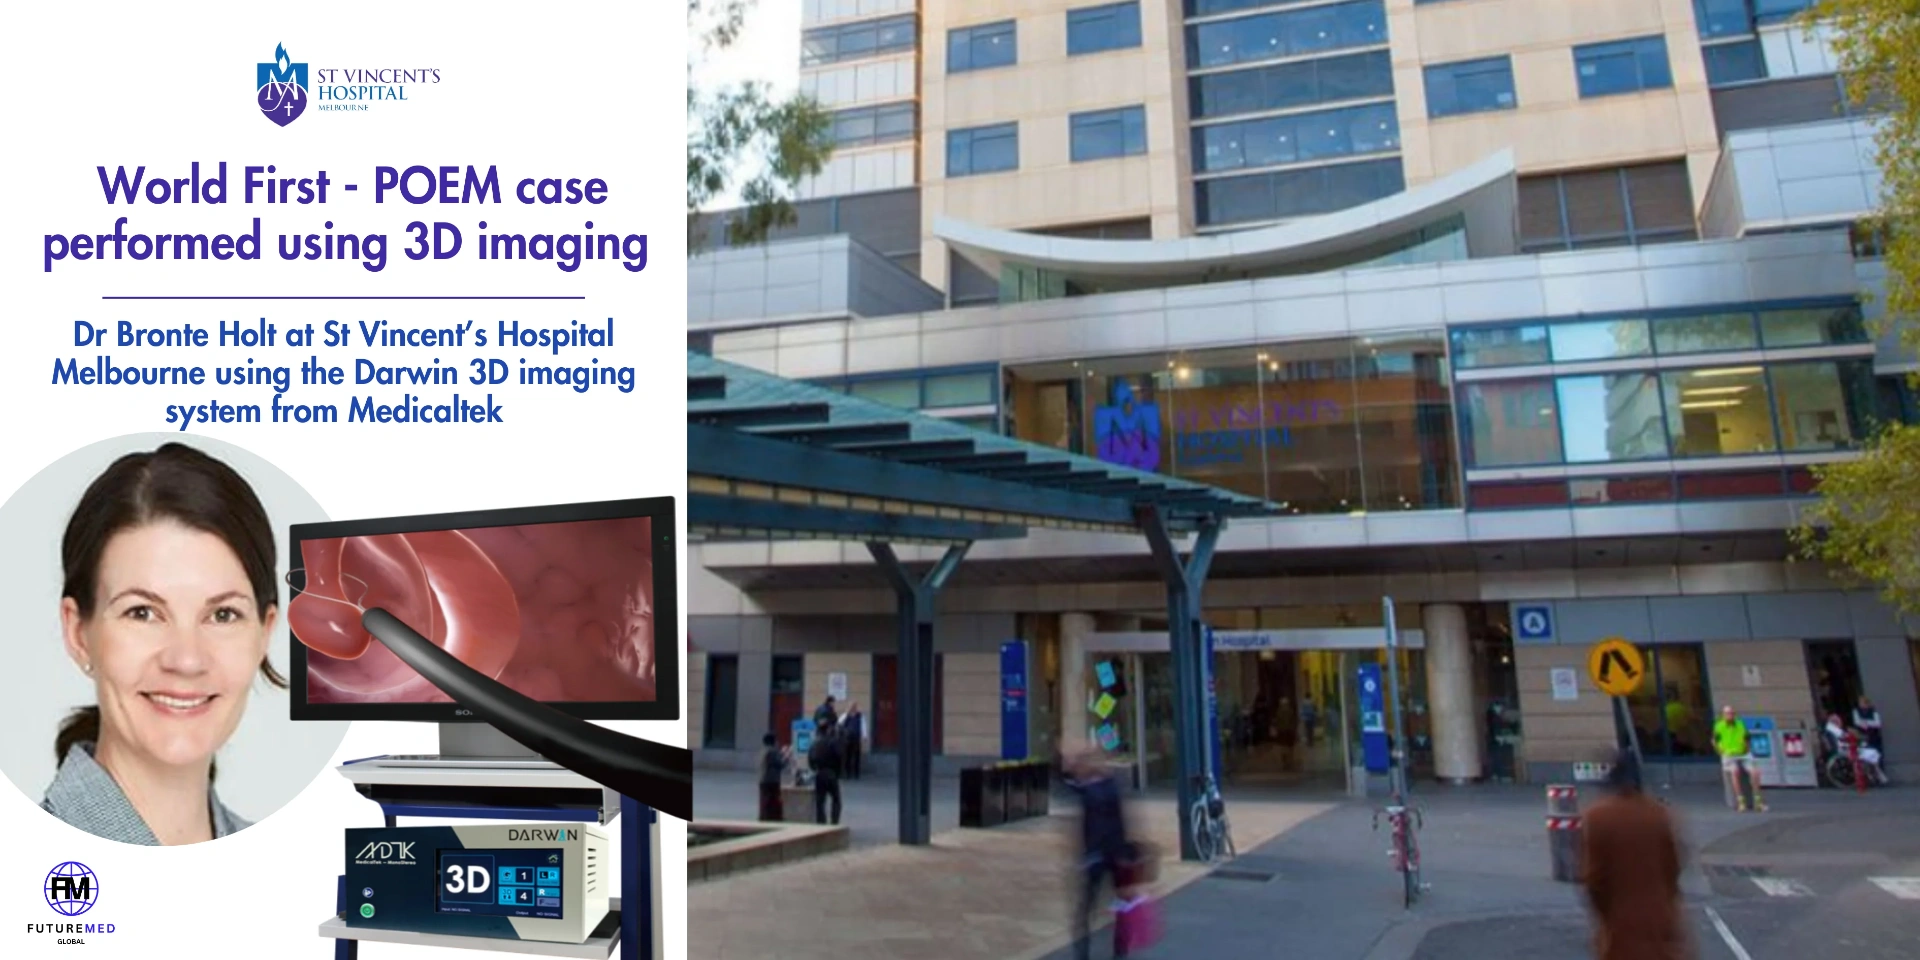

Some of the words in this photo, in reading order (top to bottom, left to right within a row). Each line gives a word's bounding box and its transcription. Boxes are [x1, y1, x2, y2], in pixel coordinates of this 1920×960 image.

[1528, 614, 1540, 629] A
[508, 828, 578, 841] DARWIN
[445, 864, 491, 894] 3D
[521, 871, 527, 881] 1
[549, 871, 557, 879] R
[519, 891, 528, 901] 4
[539, 888, 546, 896] R
